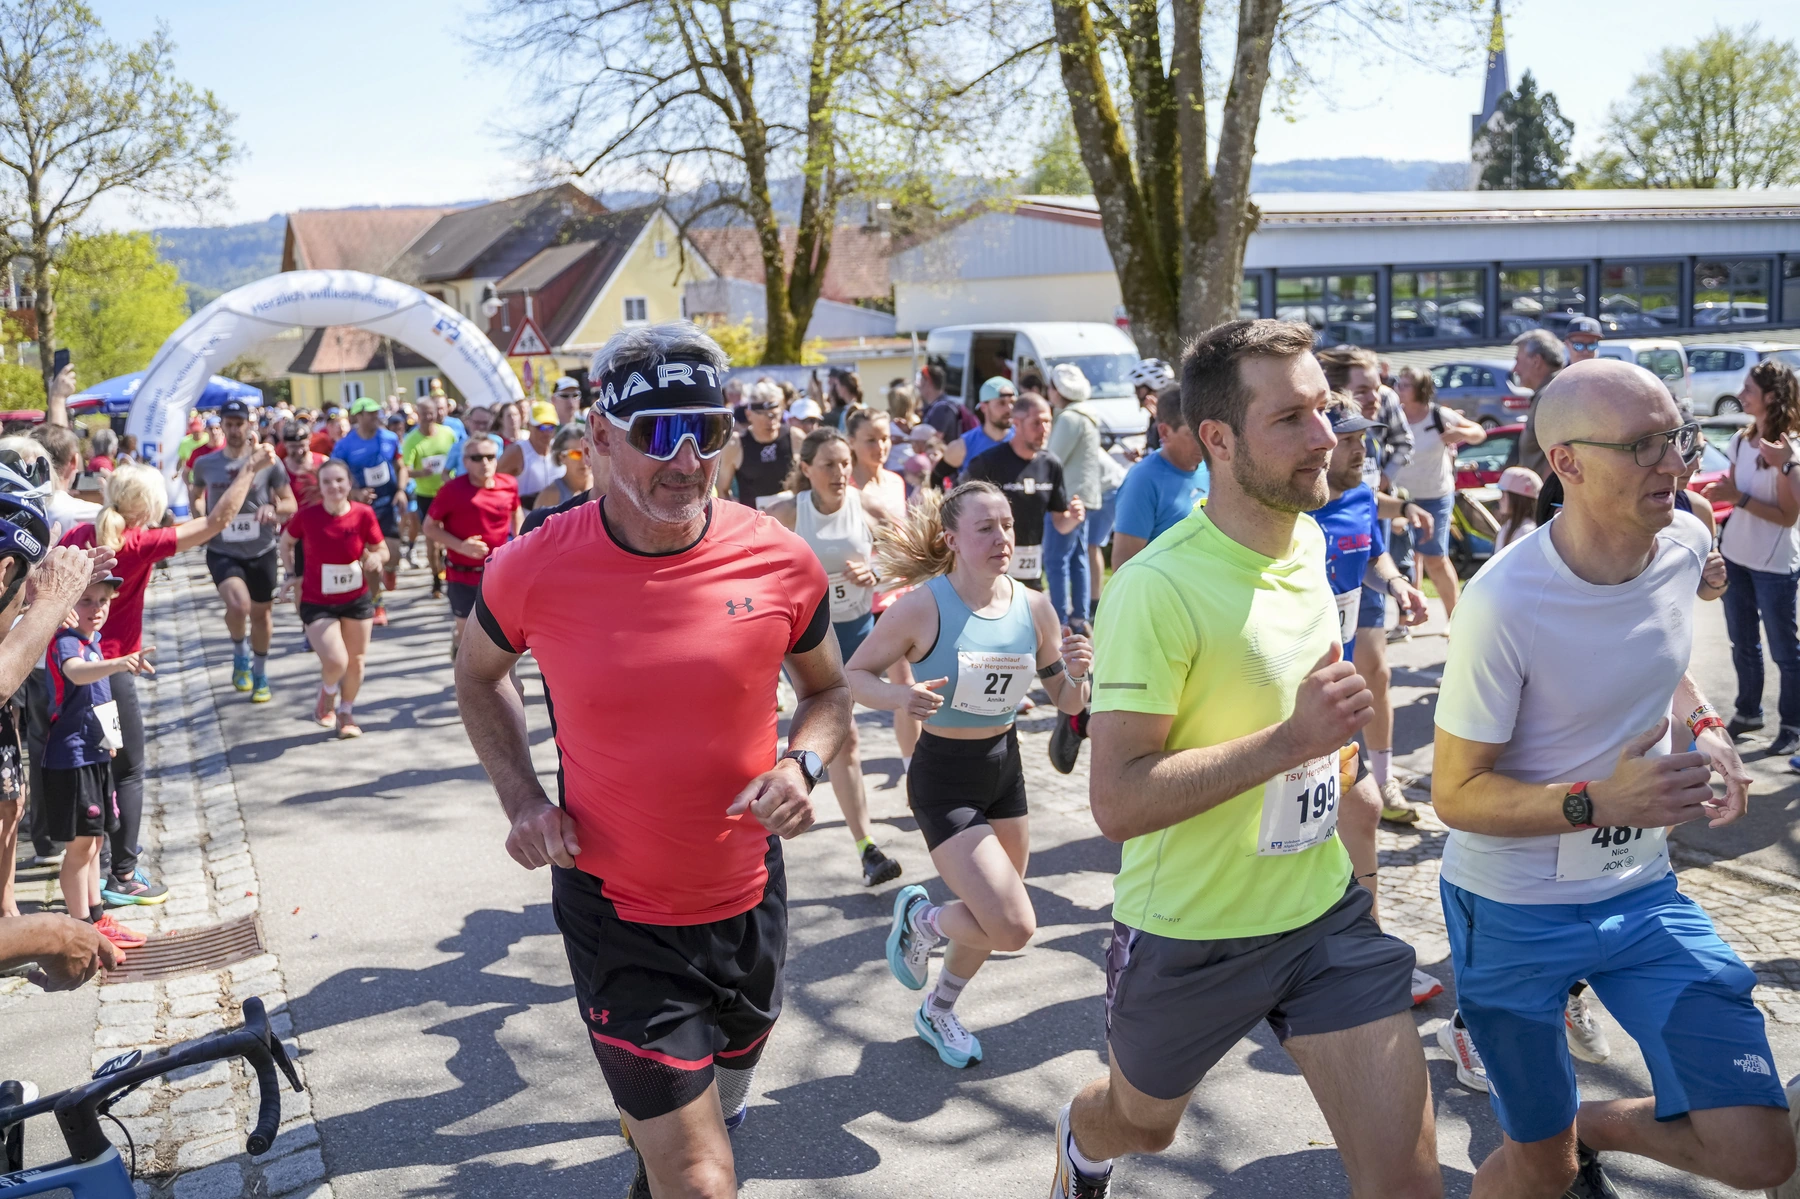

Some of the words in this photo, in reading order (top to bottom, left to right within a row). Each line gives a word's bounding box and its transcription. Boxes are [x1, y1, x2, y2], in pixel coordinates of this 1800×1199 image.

[17, 533, 39, 553] ABUS
[835, 585, 846, 599] 5
[983, 672, 1013, 695] 27
[1284, 772, 1303, 782] TSV
[1296, 775, 1335, 825] 199
[1611, 848, 1629, 857] Nico
[1601, 859, 1625, 872] AOK
[1743, 1053, 1759, 1061] THE
[1733, 1059, 1761, 1068] NORTH
[1742, 1065, 1762, 1074] FACE
